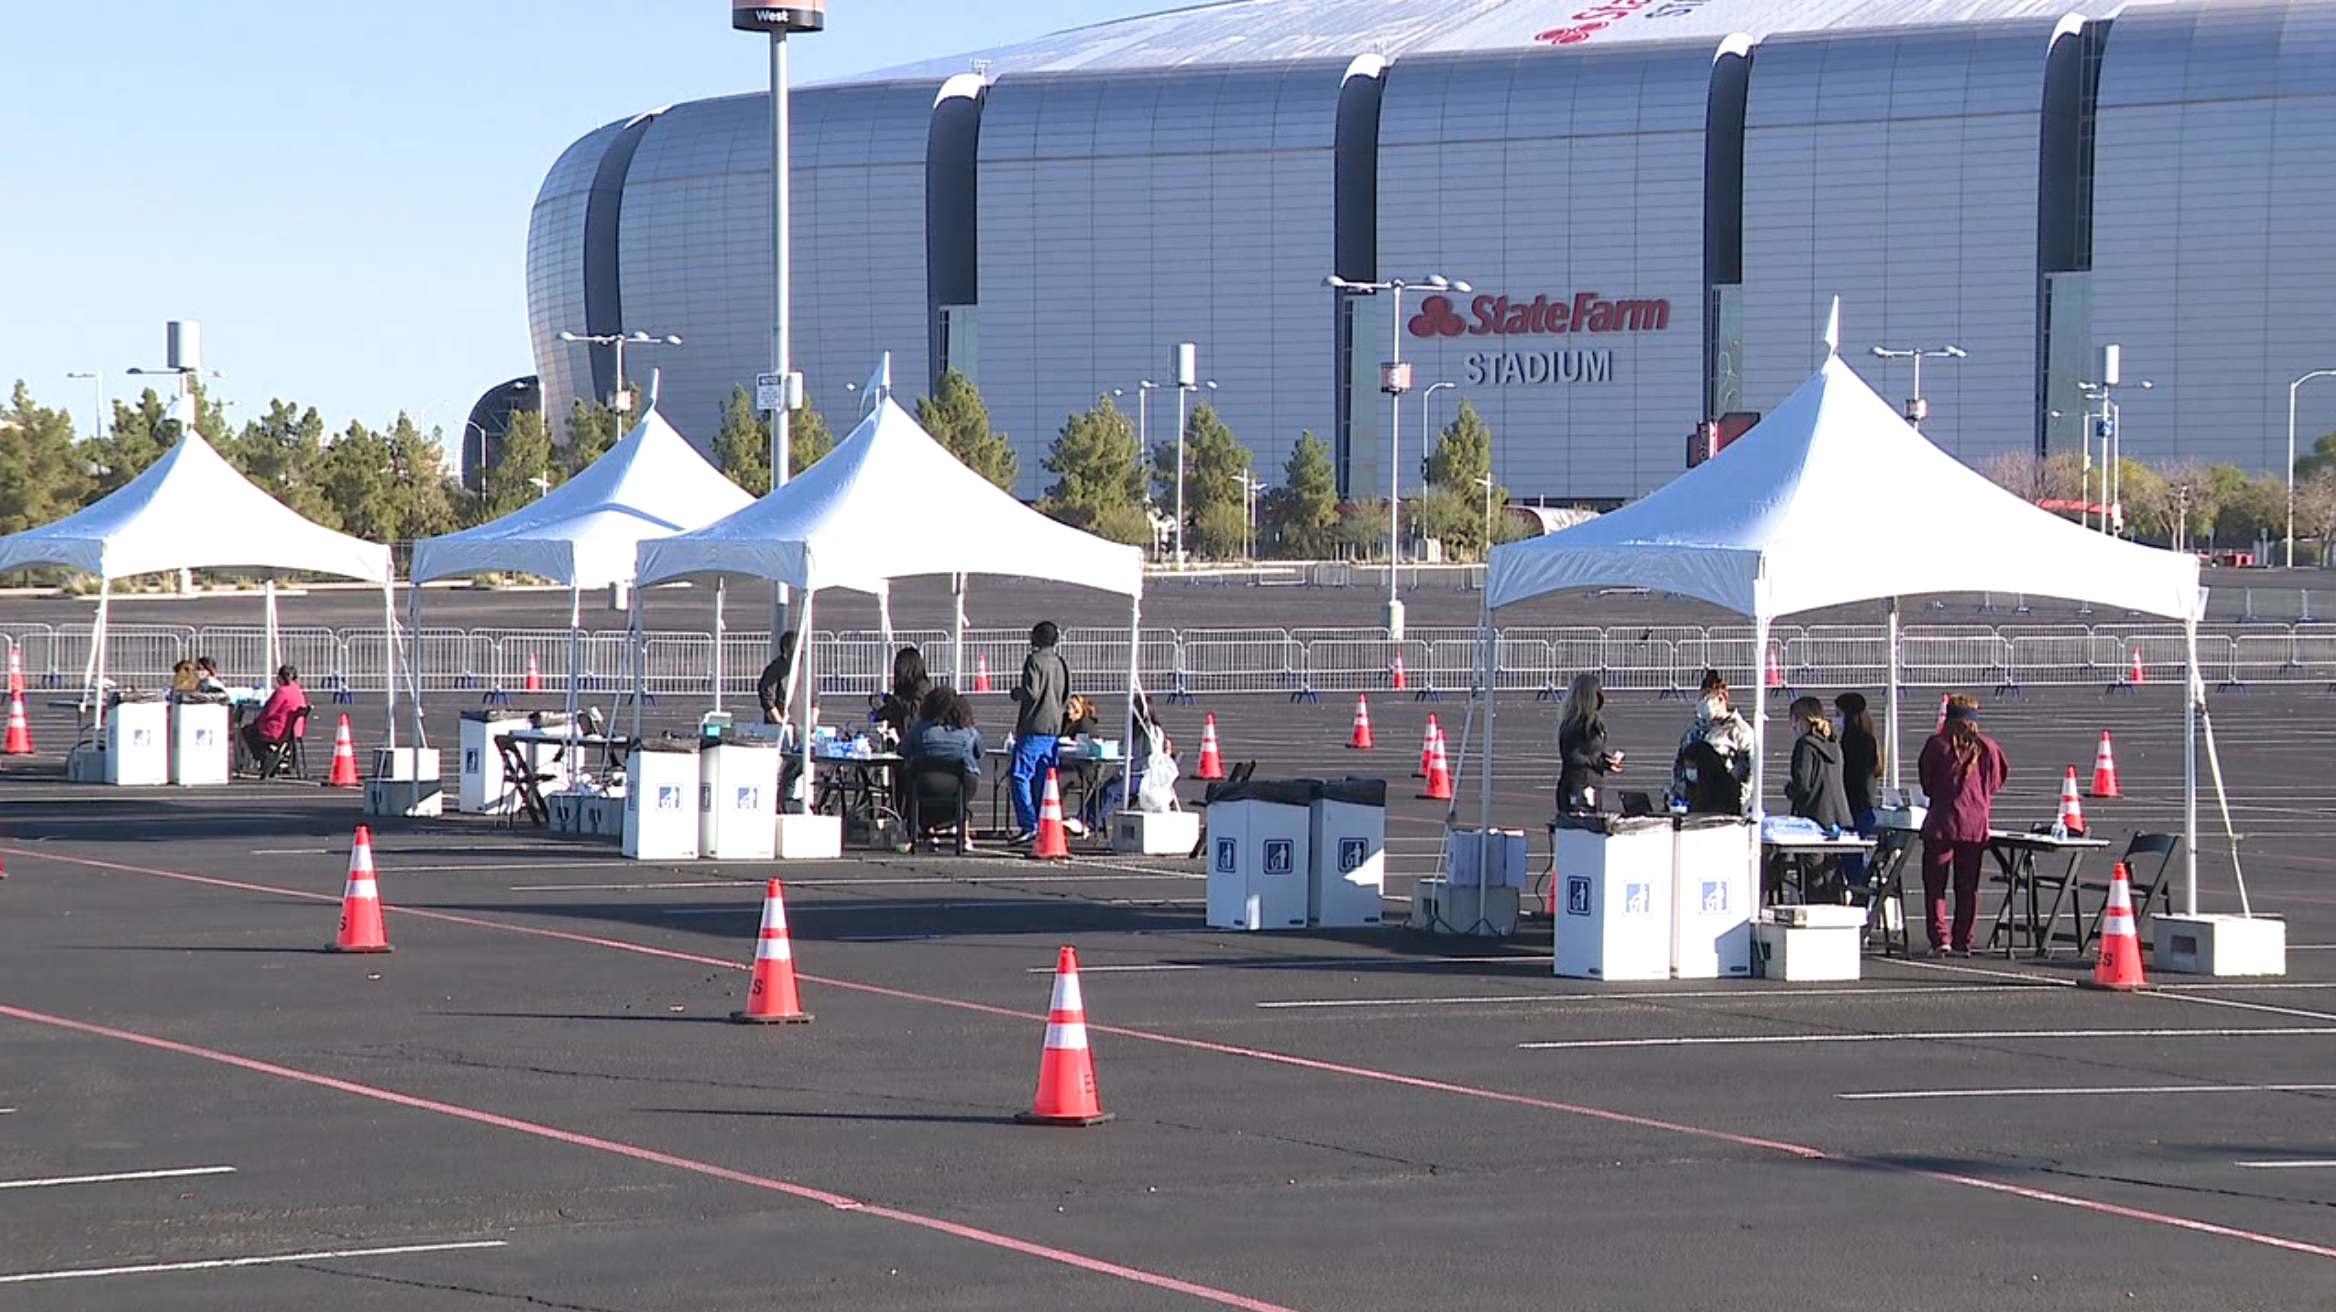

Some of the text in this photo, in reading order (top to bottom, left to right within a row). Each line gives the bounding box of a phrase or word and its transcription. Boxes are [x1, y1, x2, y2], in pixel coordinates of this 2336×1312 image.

[756, 9, 789, 23] West
[1464, 349, 1612, 385] STADIUM
[753, 978, 763, 995] S
